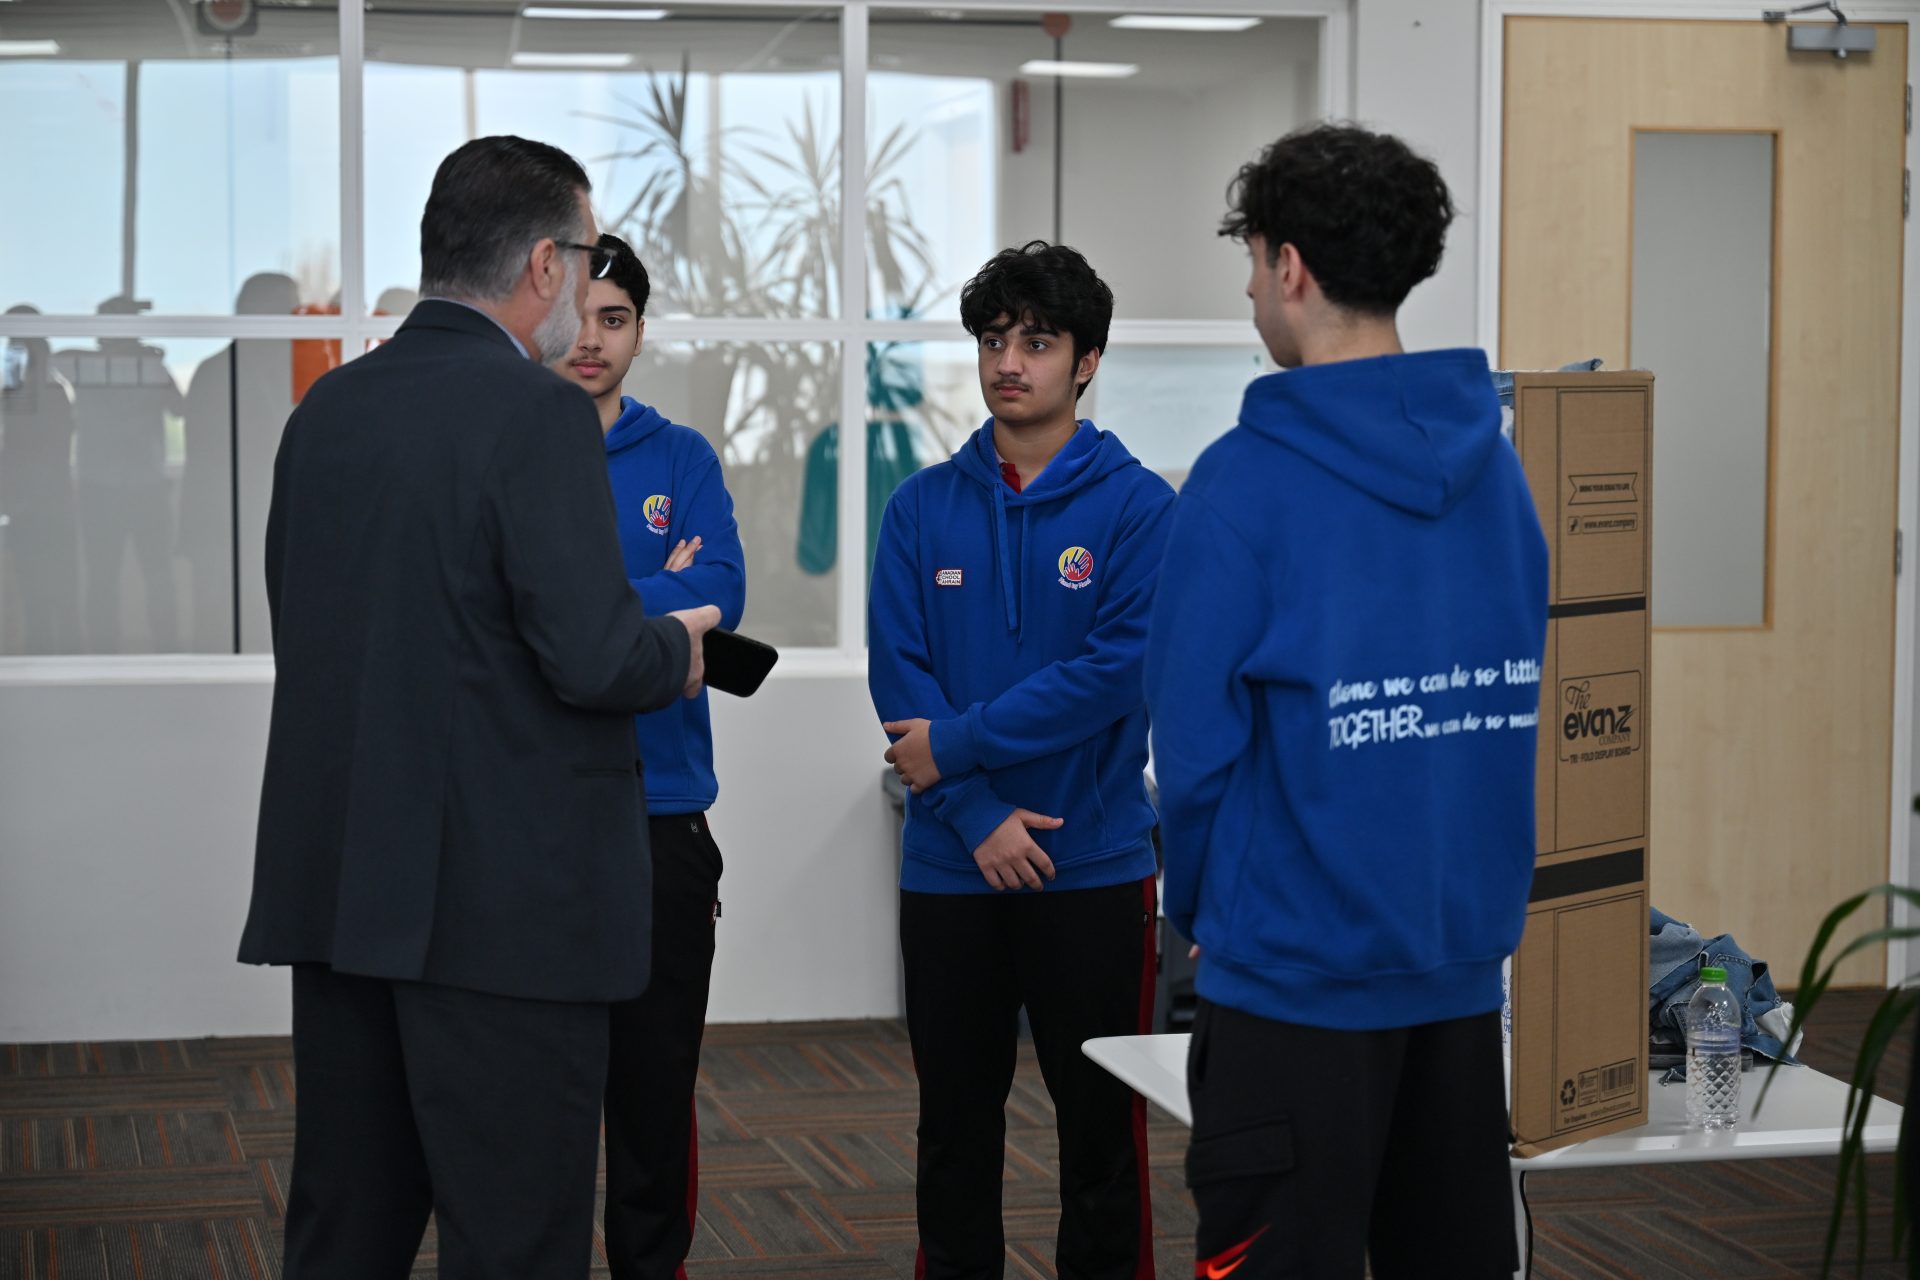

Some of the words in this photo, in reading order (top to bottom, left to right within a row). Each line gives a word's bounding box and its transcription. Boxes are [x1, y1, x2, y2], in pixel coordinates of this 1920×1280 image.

[1383, 676, 1415, 697] we
[1419, 673, 1448, 694] can
[1450, 663, 1470, 688] do
[1474, 667, 1500, 687] so
[1565, 680, 1592, 711] The
[1328, 704, 1425, 751] TOGETHER
[1424, 722, 1440, 738] we
[1441, 718, 1461, 735] can
[1462, 711, 1483, 731] do
[1485, 714, 1507, 730] so
[1563, 704, 1638, 741] evanz
[1598, 733, 1631, 746] COMPANY
